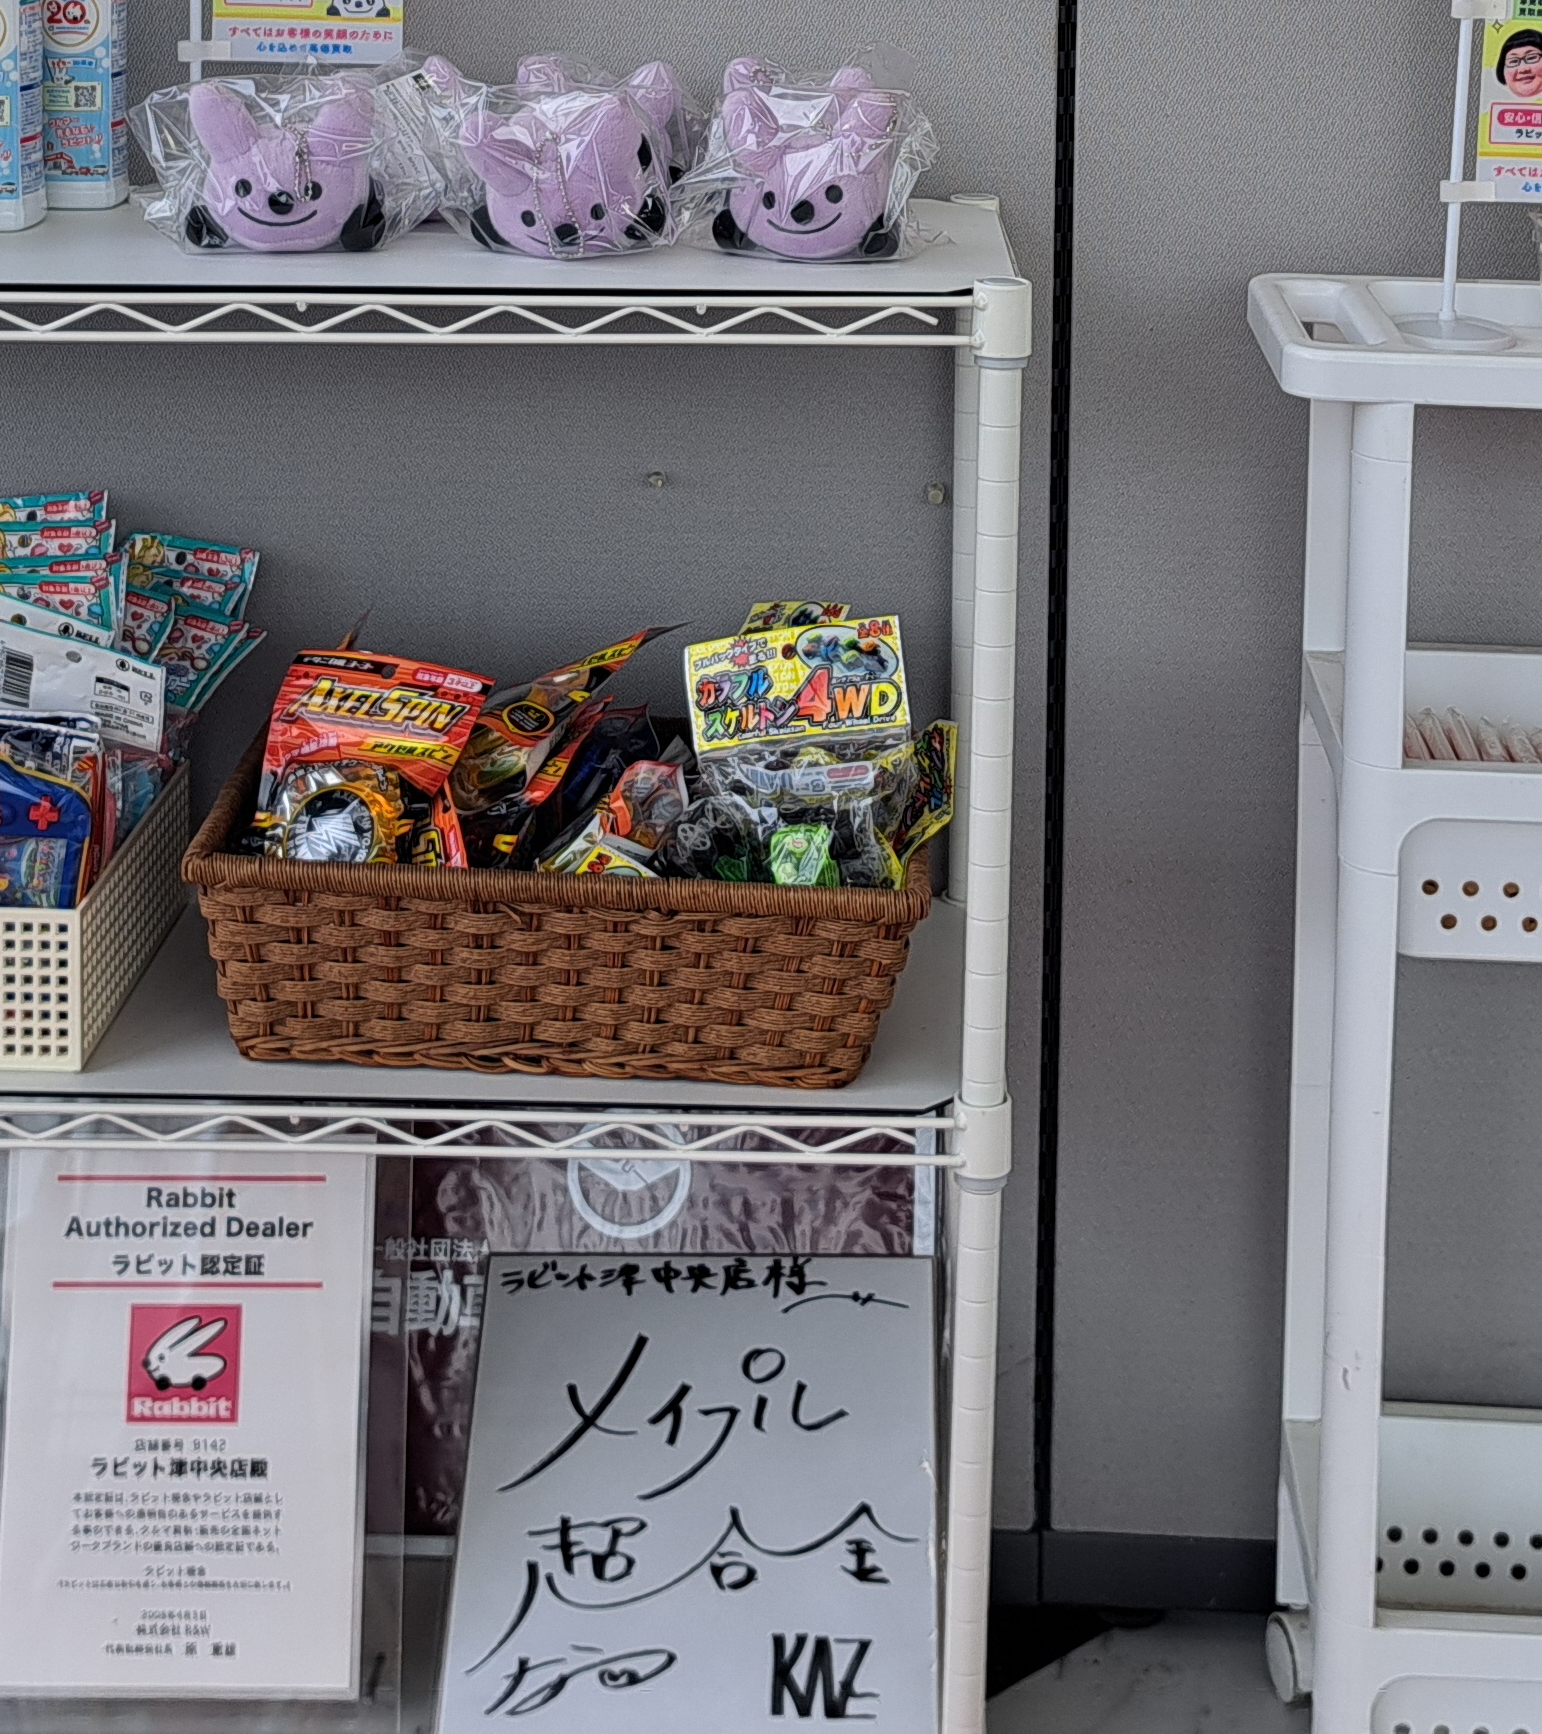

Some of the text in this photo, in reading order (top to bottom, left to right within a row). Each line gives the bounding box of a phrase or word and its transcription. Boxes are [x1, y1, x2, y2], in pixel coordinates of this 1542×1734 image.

[697, 666, 900, 741] カラフル スケルトン 4WD
[146, 1187, 236, 1208] Rabbit
[65, 1217, 313, 1238] Authorized Dealer
[113, 1254, 265, 1276] ラビット認定証
[132, 1397, 232, 1417] Rabbit
[496, 1333, 850, 1501] メイプル
[92, 1457, 268, 1479] ラビット津中央店殿
